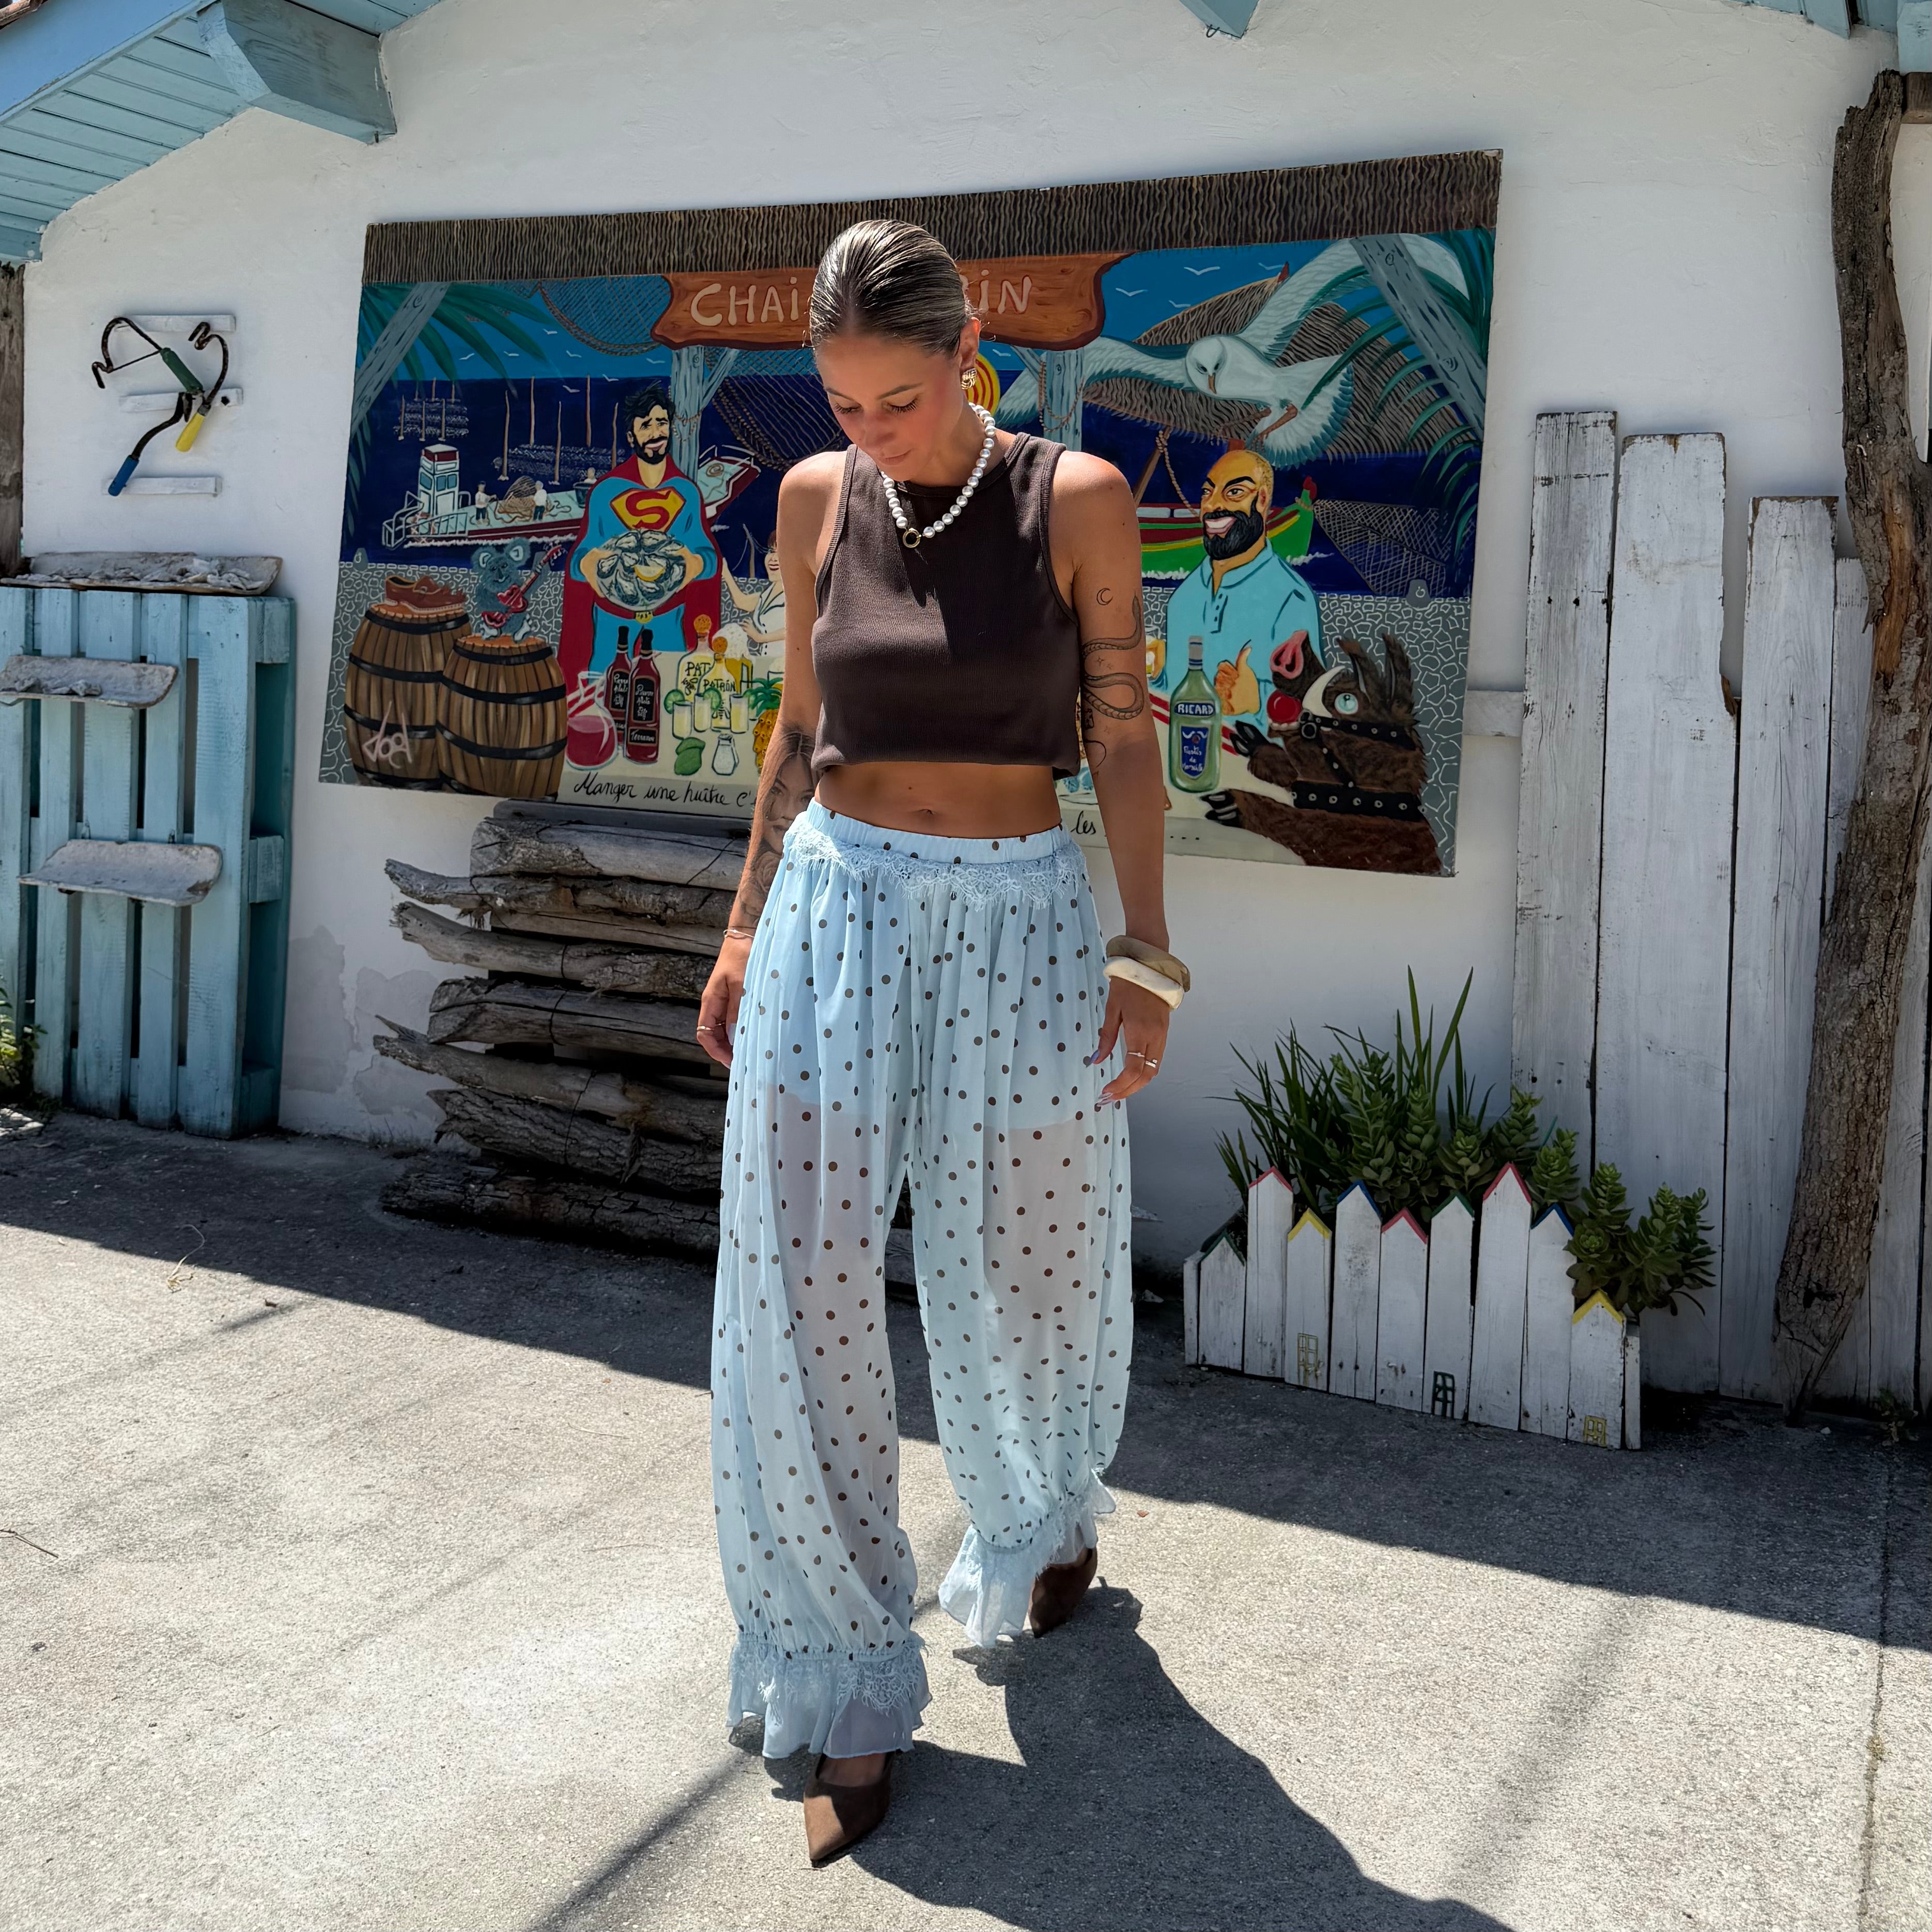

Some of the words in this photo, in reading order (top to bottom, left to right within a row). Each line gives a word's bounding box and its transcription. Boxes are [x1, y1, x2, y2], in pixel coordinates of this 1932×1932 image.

[685, 661, 712, 676] PAT
[1178, 703, 1214, 715] RICARD
[574, 771, 637, 803] Manger
[643, 785, 680, 801] une
